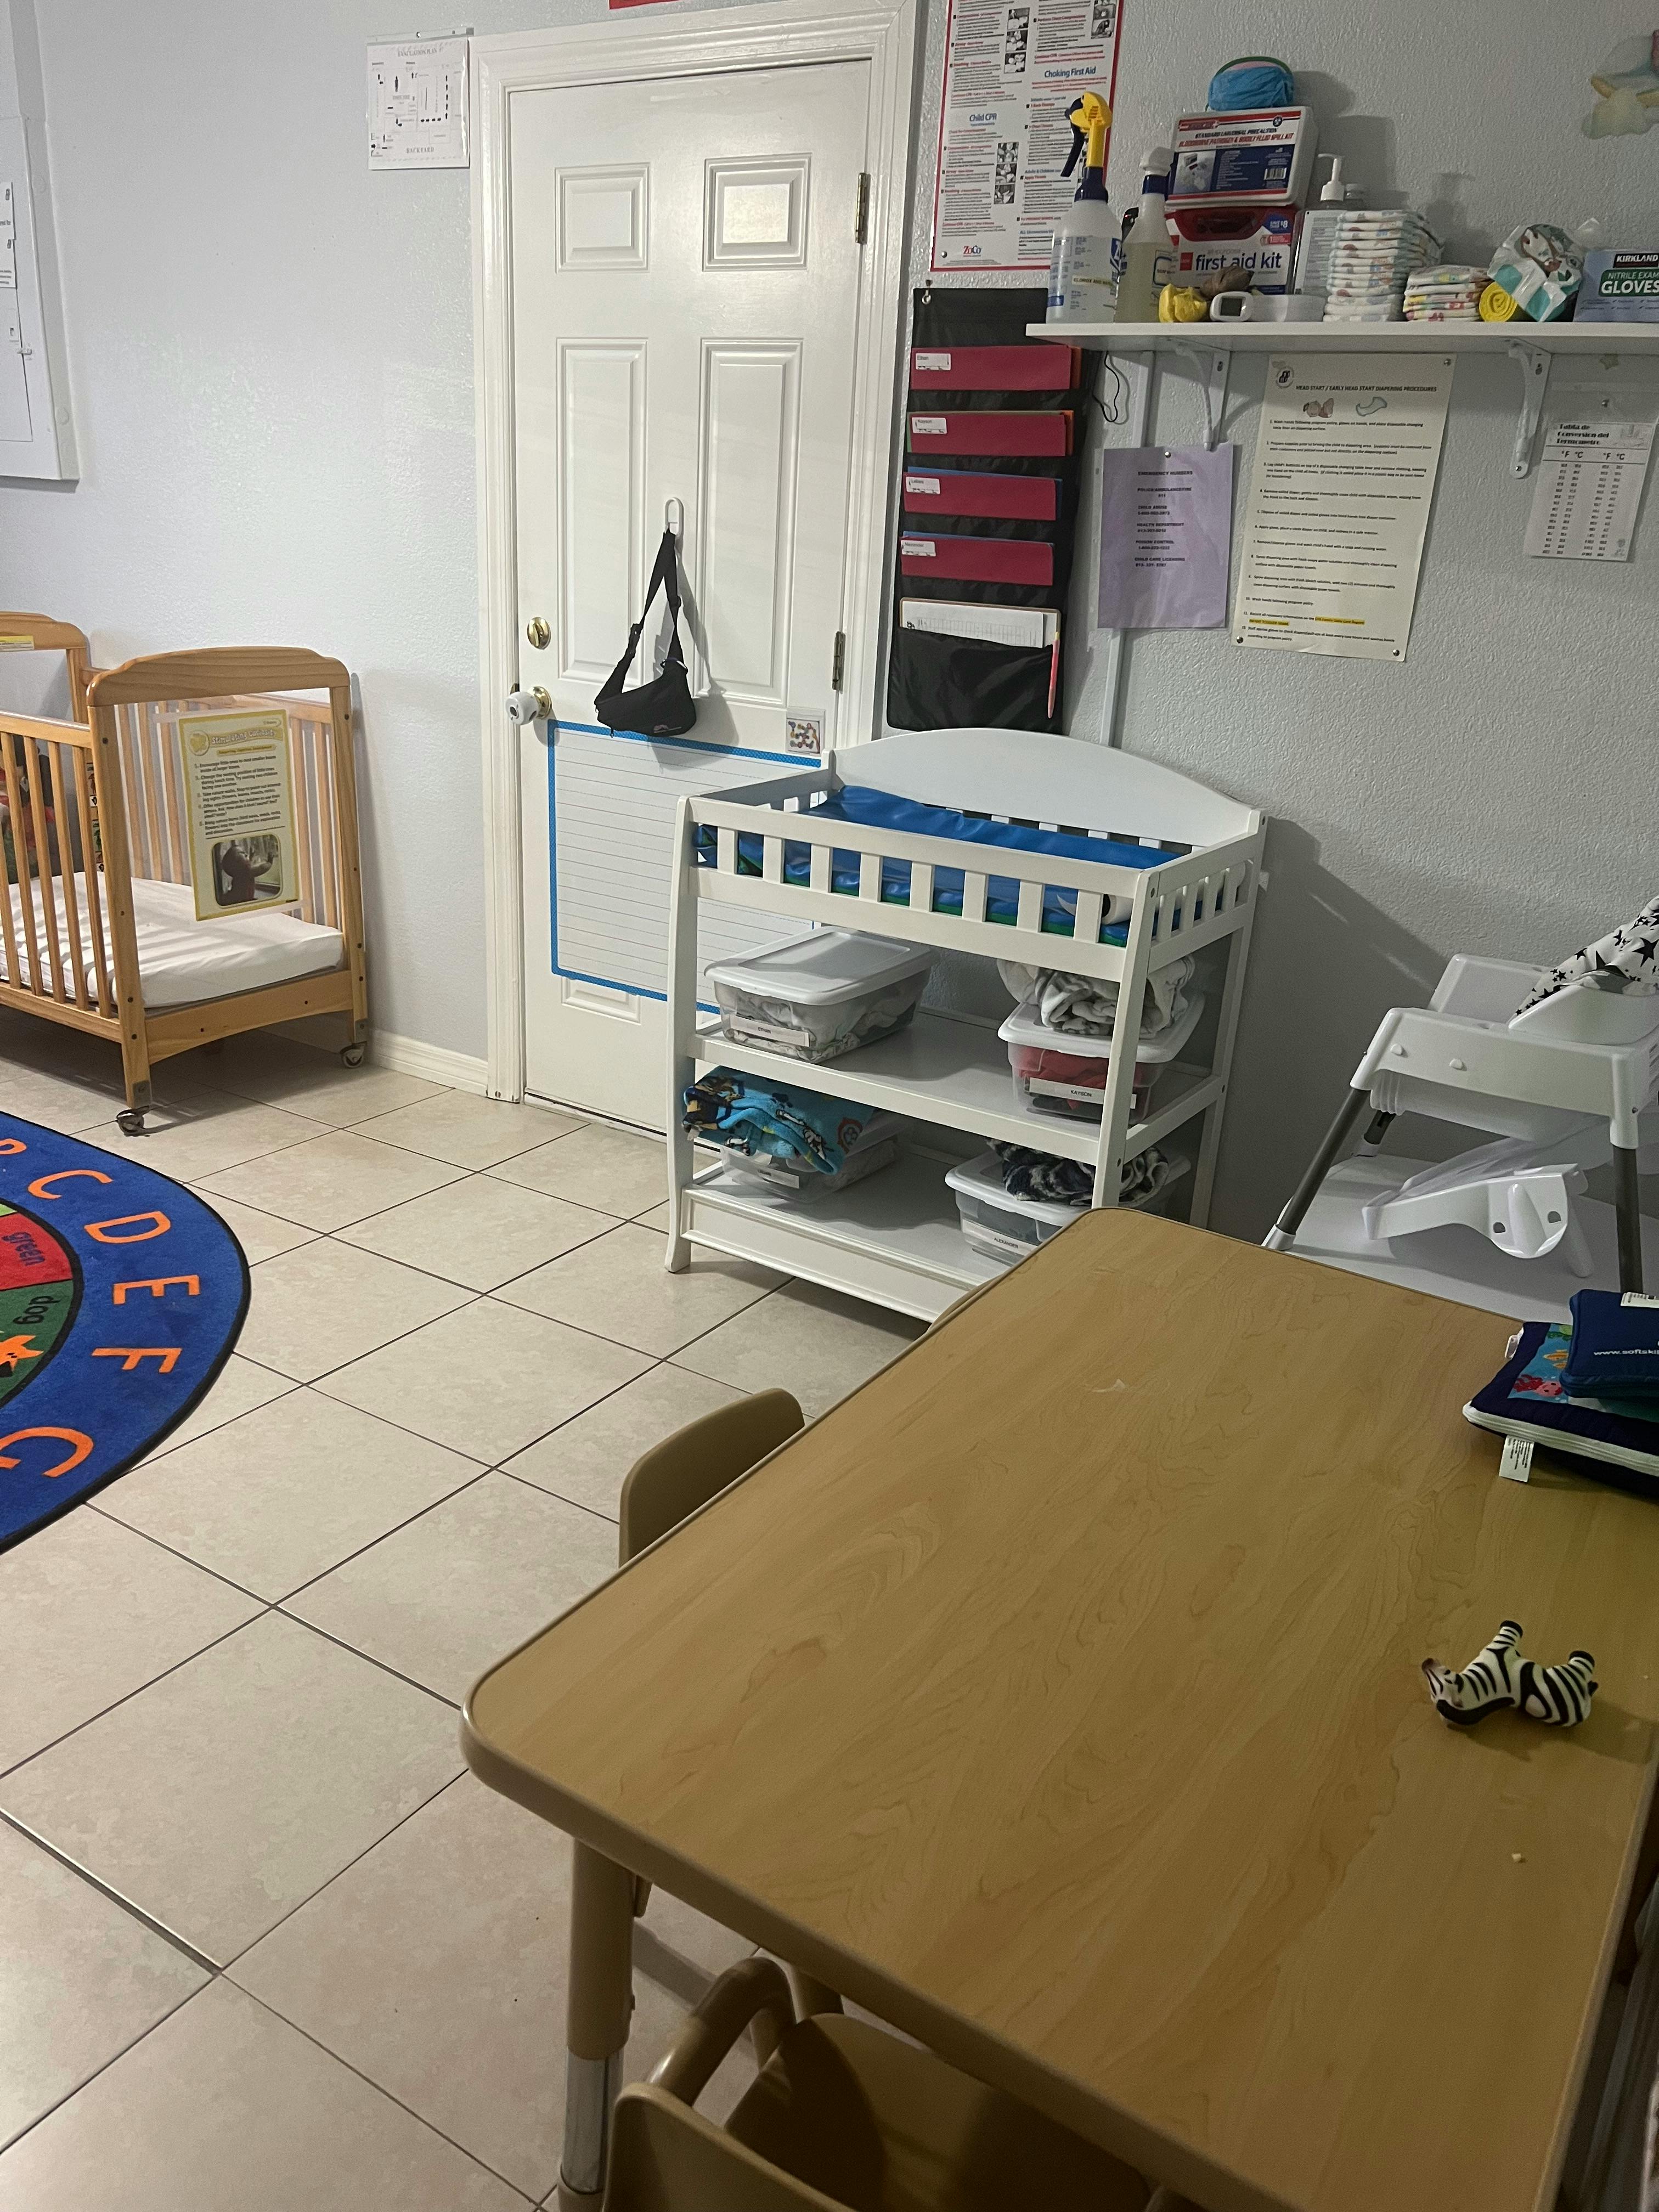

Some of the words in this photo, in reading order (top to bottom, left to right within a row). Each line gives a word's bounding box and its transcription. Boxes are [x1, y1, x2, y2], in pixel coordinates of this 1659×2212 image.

[1045, 69, 1070, 78] Choking
[963, 245, 981, 255] ZoCo
[1196, 255, 1227, 270] first
[1232, 252, 1256, 269] aid
[1261, 252, 1282, 268] kit
[1601, 280, 1659, 294] GLOVES
[212, 732, 247, 744] Stimulating
[28, 1170, 113, 1199] C
[84, 1211, 171, 1244] D
[2, 1231, 46, 1266] green
[112, 1274, 201, 1306] E
[13, 1295, 61, 1324] dog
[92, 1347, 183, 1374] F
